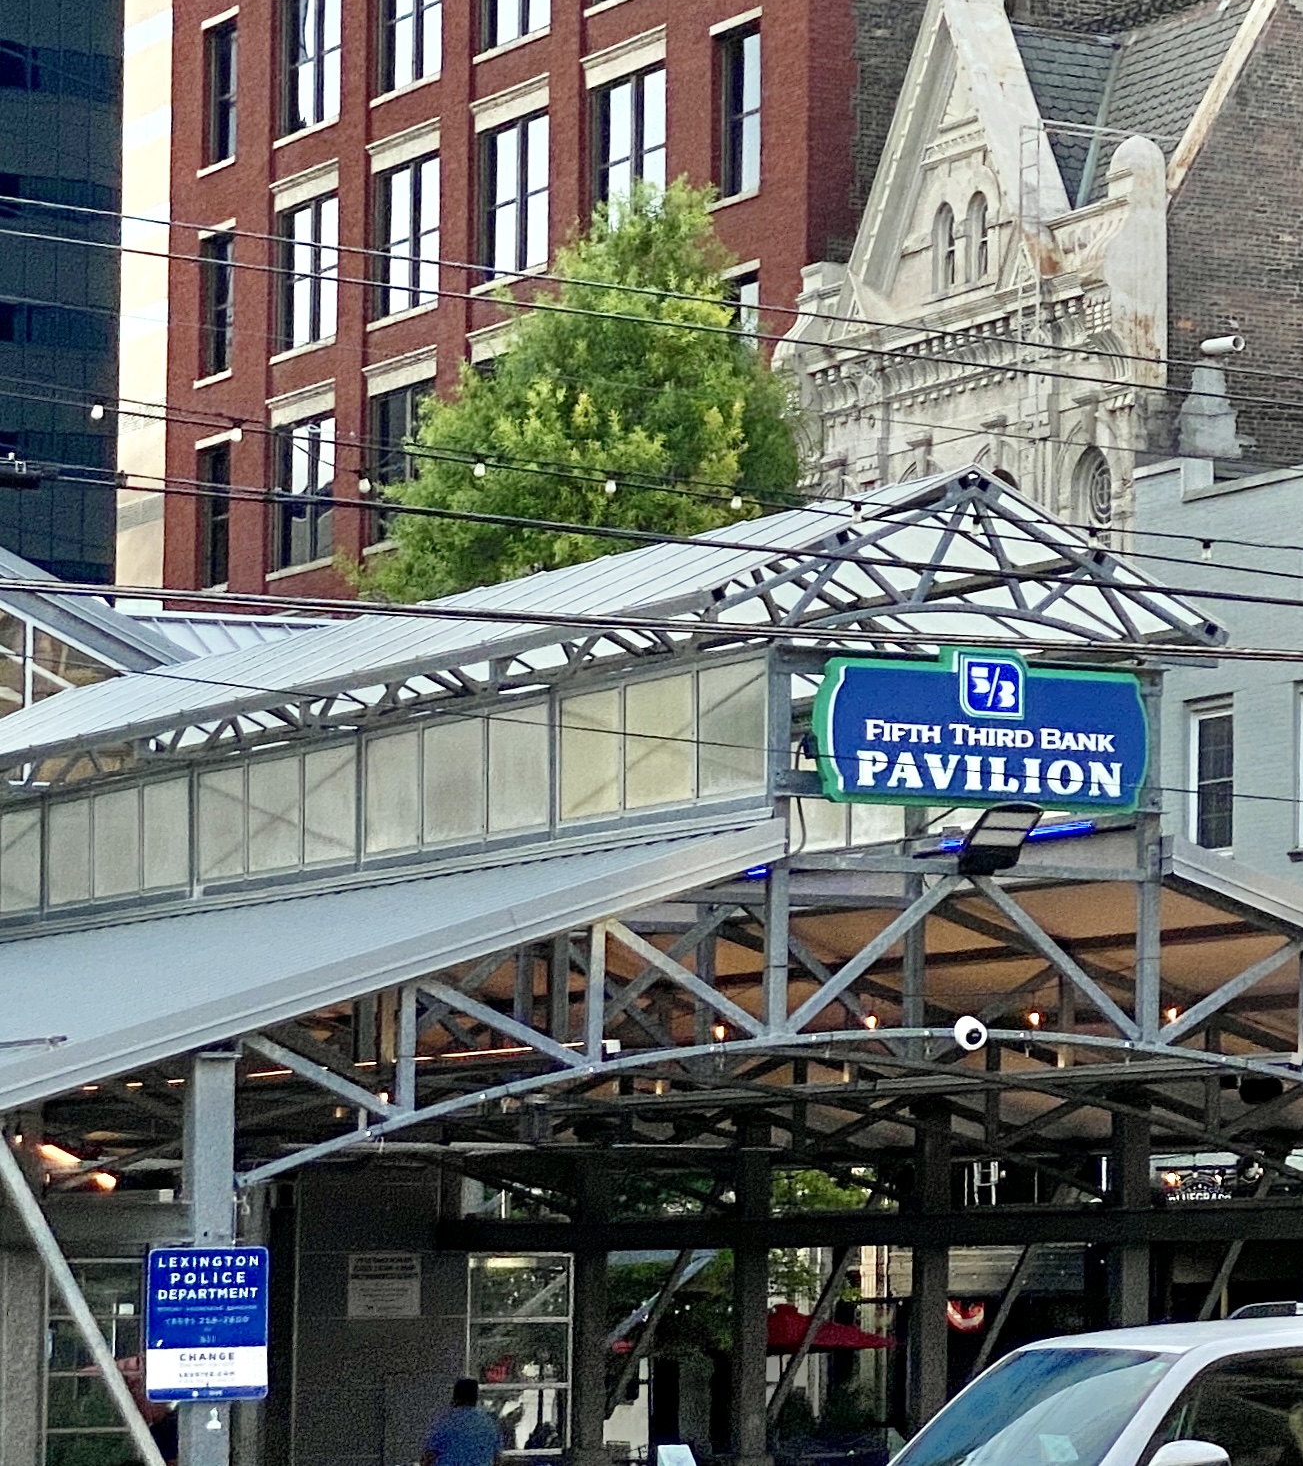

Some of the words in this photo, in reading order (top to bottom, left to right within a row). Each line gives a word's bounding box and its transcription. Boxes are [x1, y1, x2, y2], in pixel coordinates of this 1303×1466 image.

[865, 719, 943, 744] FIFTH
[949, 722, 1034, 748] THIRD
[1040, 728, 1116, 753] BANK
[856, 750, 1123, 798] PAVILION
[158, 1255, 259, 1268] LEXINGTON
[170, 1272, 246, 1284] POLICE
[157, 1287, 258, 1300] DEPARTMENT
[179, 1352, 235, 1362] CHANGE
